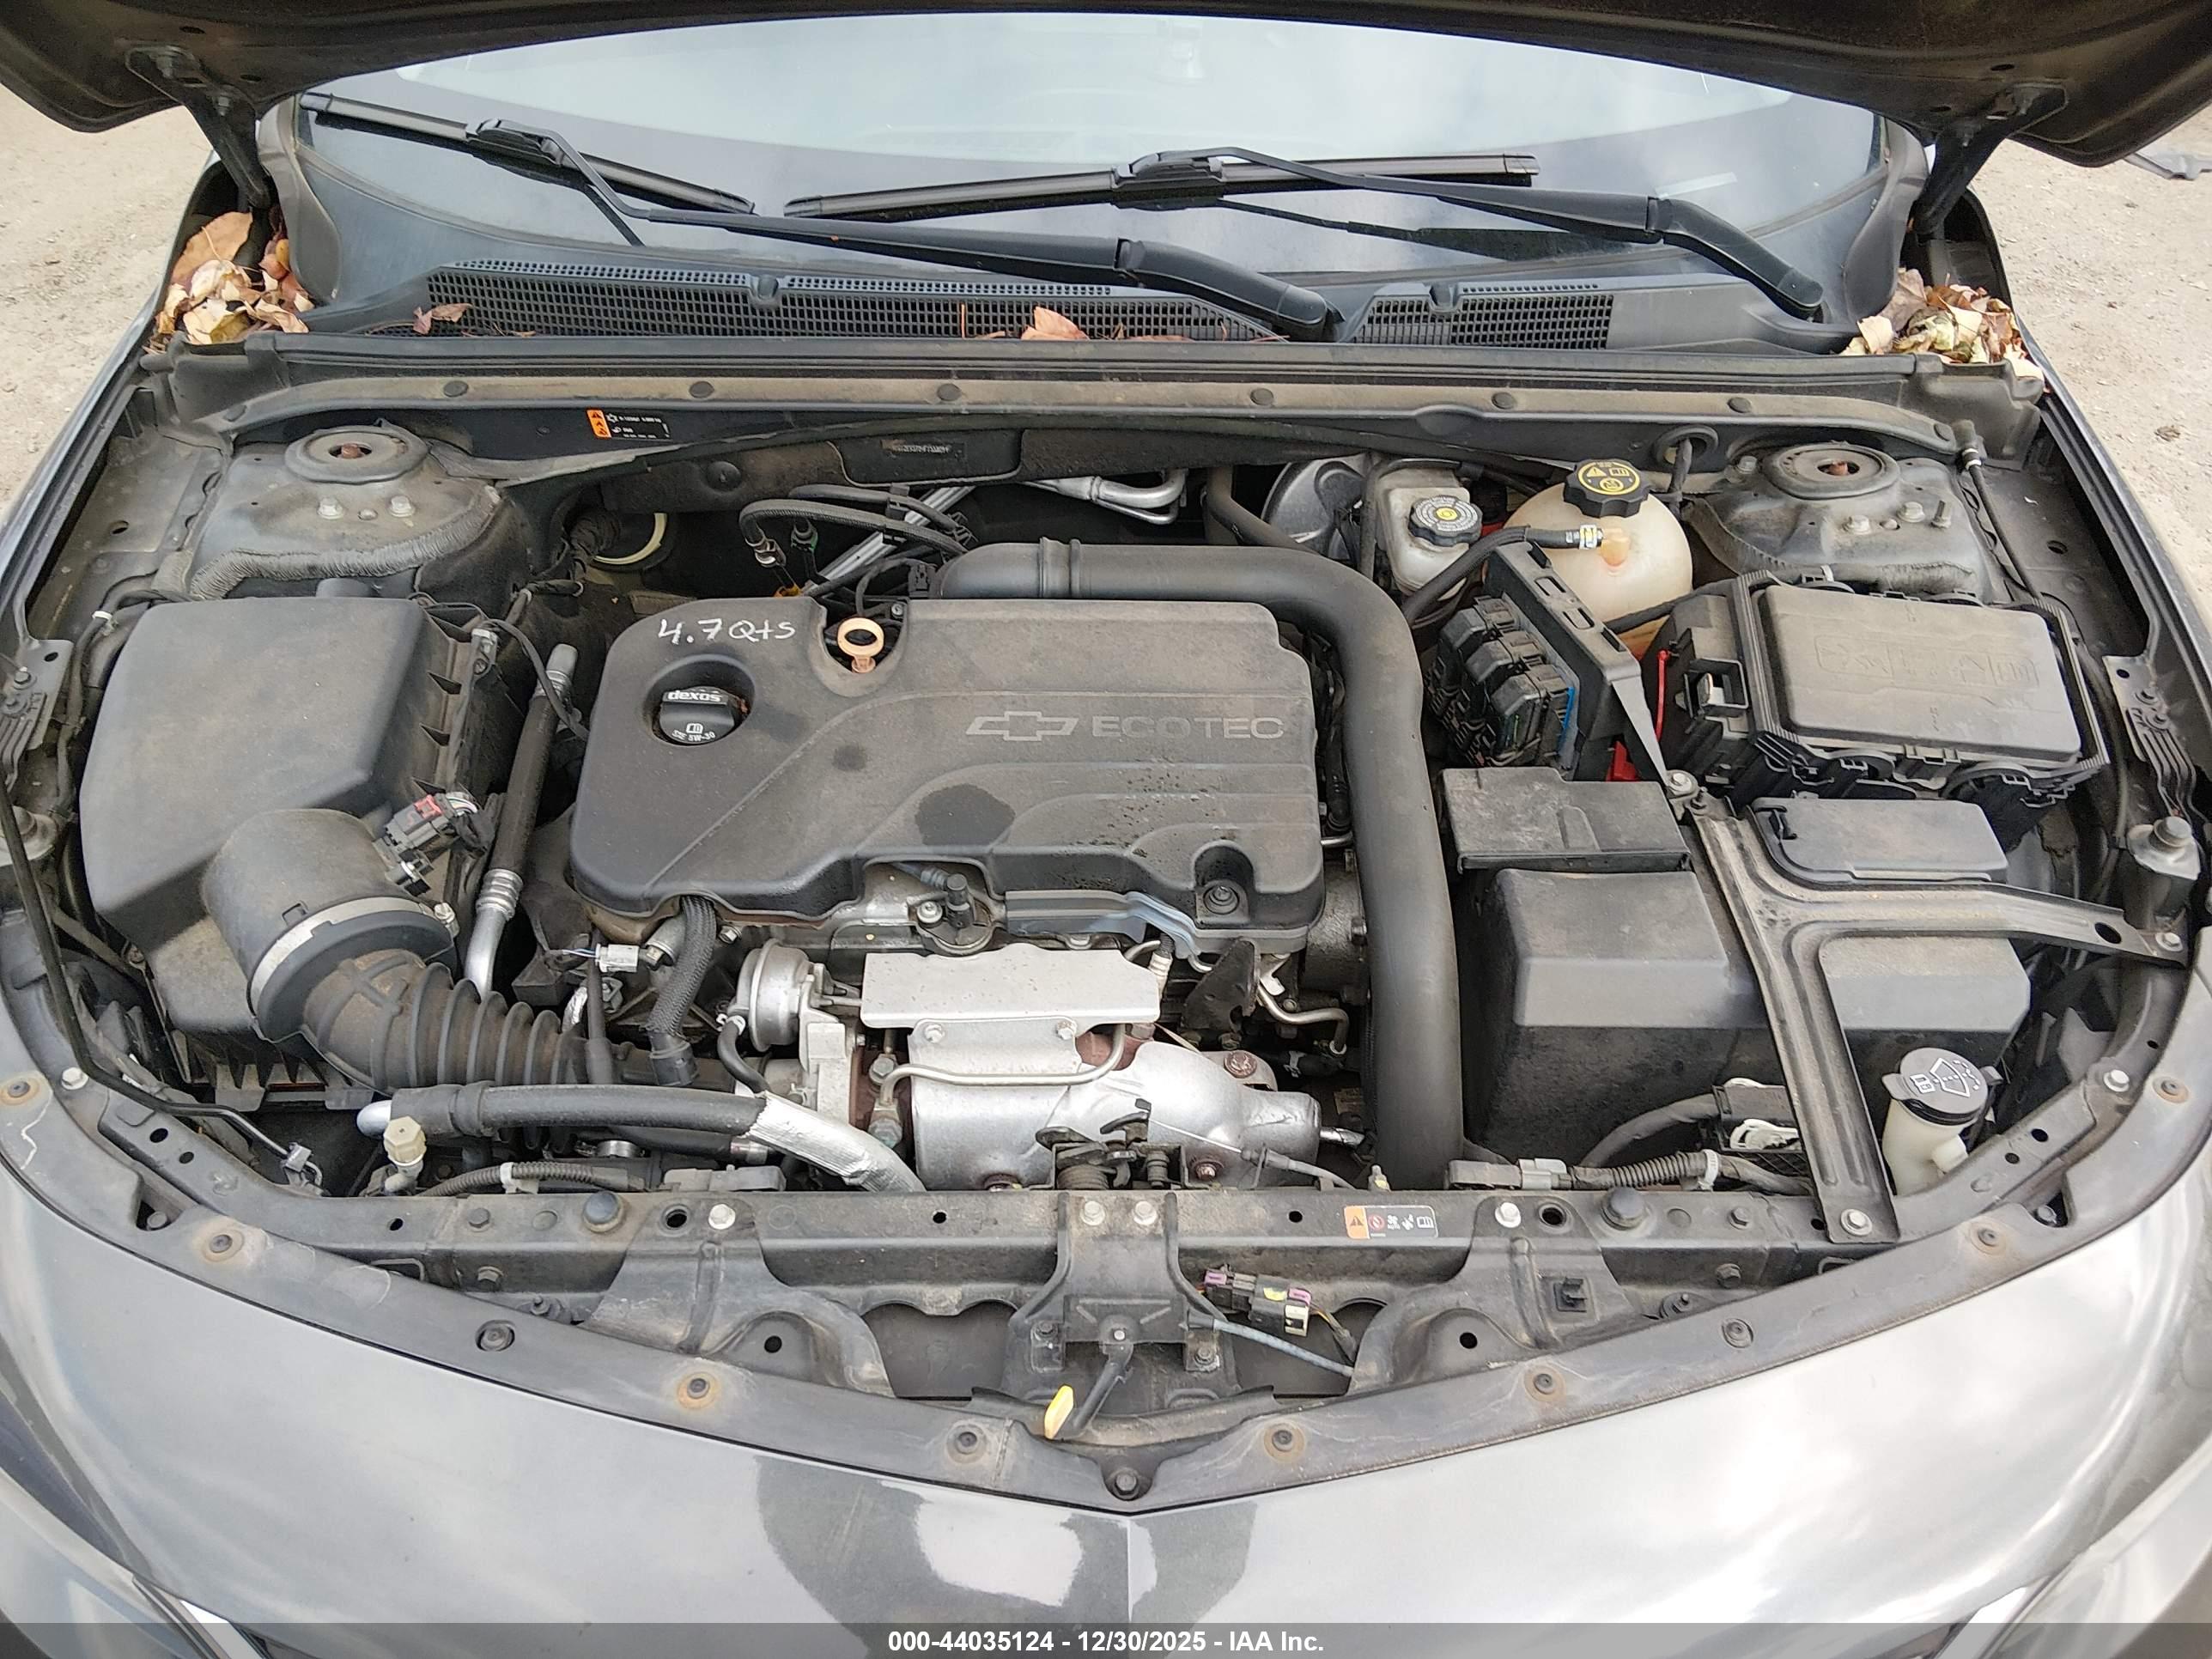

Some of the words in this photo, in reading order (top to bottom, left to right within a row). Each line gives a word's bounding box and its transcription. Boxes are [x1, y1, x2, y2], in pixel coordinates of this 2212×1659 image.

[658, 617, 722, 644] 4.7
[667, 690, 724, 702] dexos
[1091, 715, 1285, 740] ECOTEC
